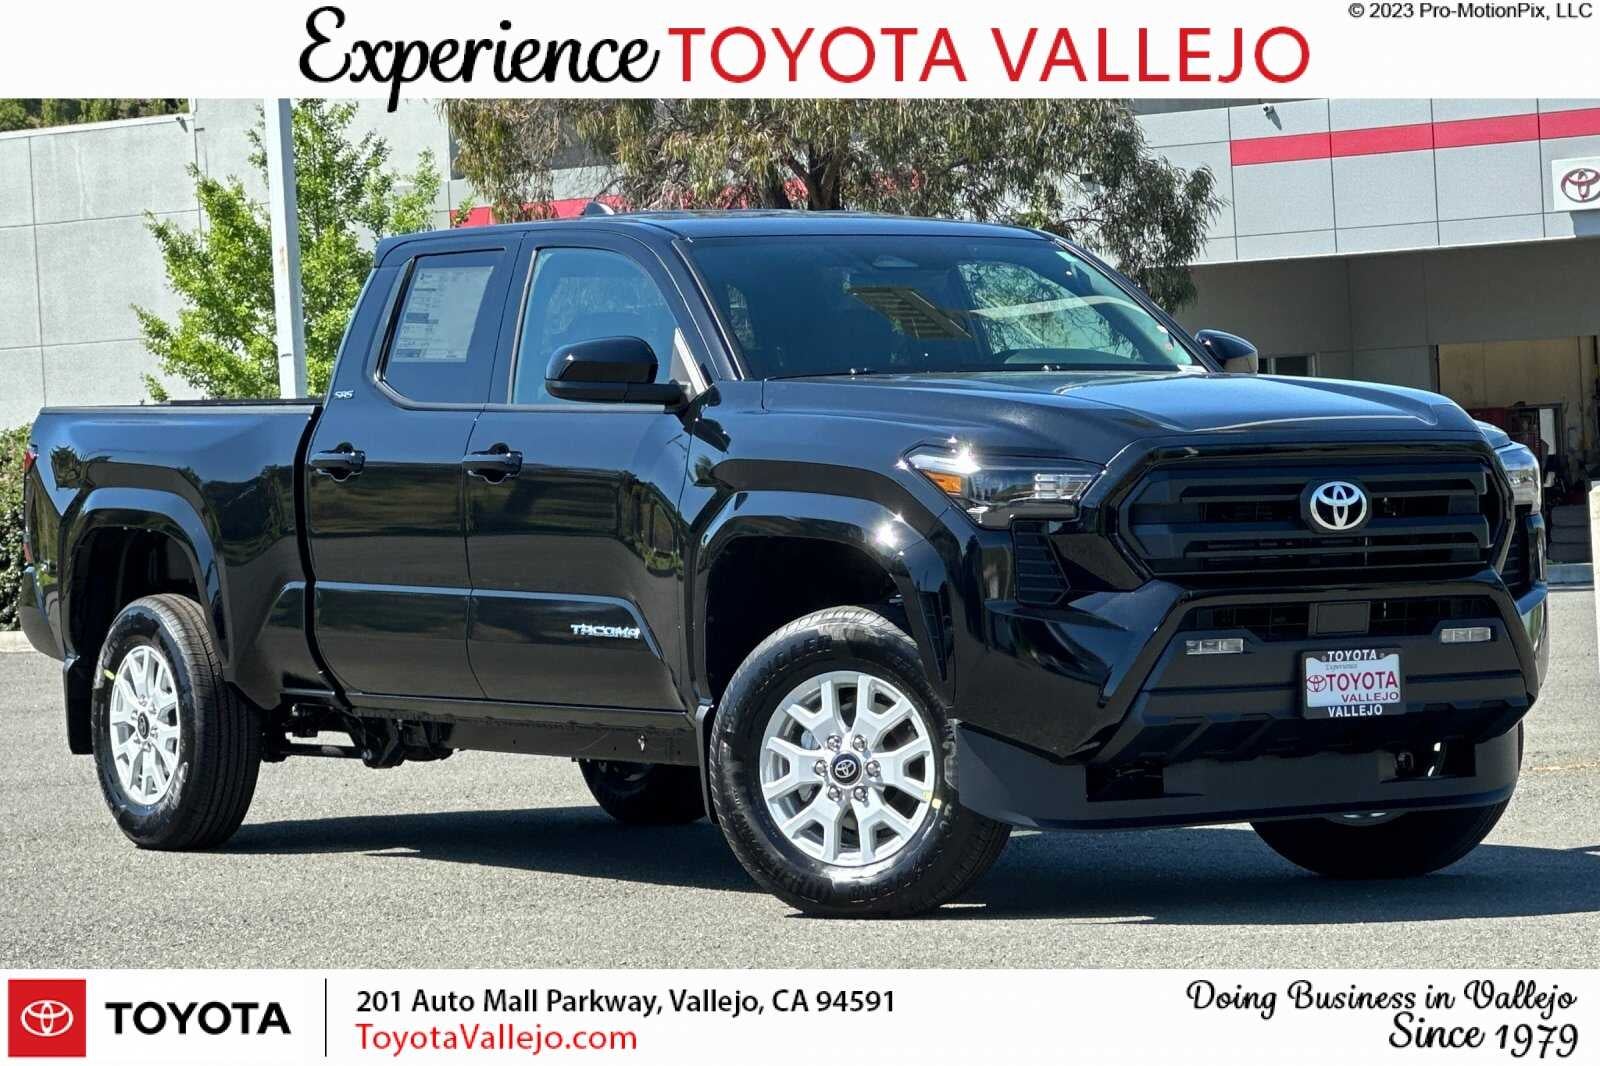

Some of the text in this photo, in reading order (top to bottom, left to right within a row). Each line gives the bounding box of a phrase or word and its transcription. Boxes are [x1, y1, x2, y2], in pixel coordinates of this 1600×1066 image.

[570, 624, 641, 640] TACOMA
[1328, 649, 1377, 662] TOYOTA
[1326, 671, 1398, 692] TOYOTA
[1341, 691, 1398, 702] VALLEJO
[1328, 704, 1383, 718] VALLEJO
